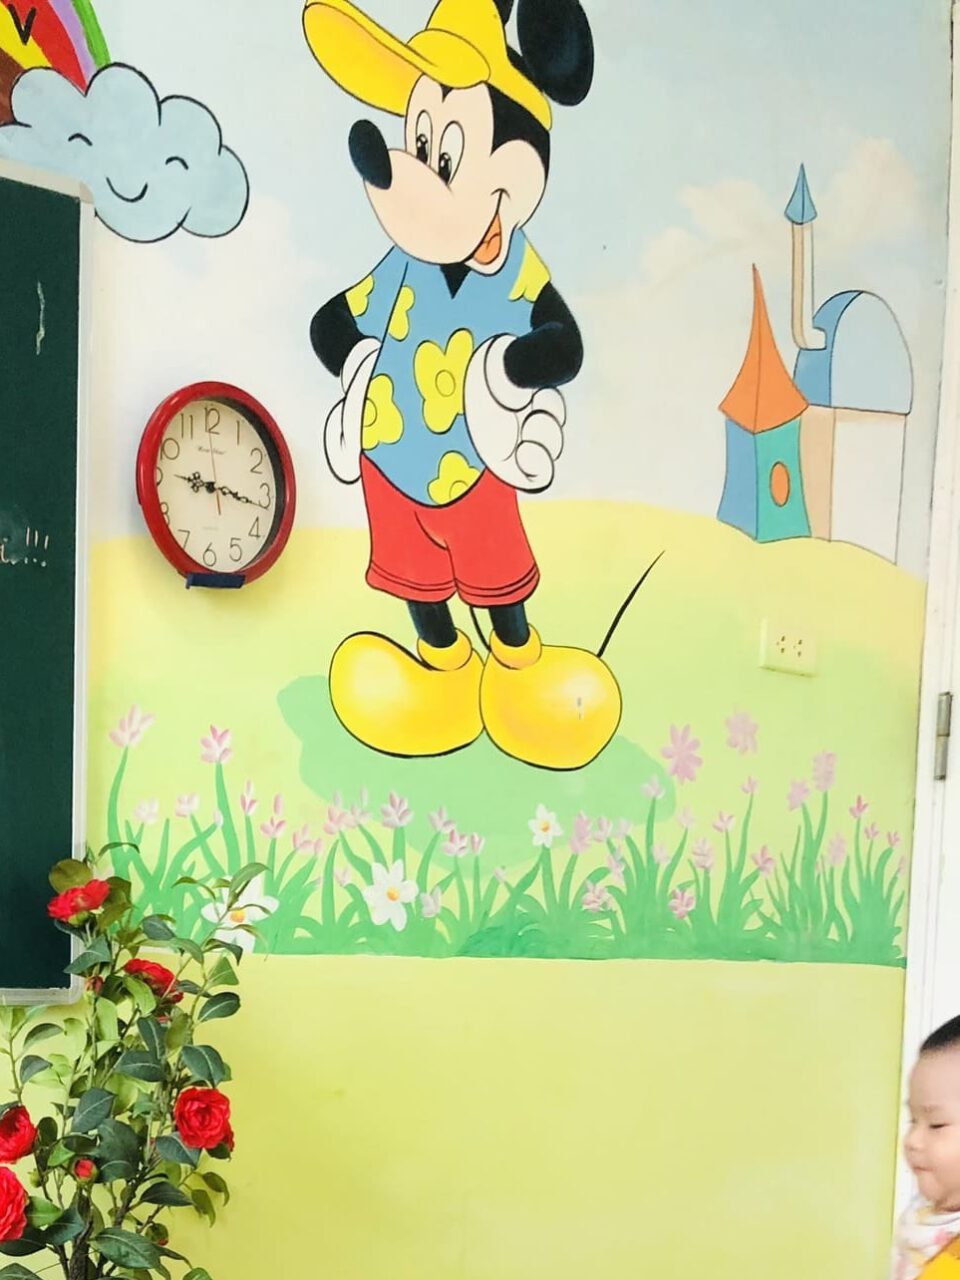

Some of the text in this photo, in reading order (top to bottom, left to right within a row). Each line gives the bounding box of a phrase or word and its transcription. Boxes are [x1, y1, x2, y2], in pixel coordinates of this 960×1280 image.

[7, 4, 37, 45] V
[179, 413, 241, 446] 11 1
[204, 407, 220, 435] 12
[249, 447, 263, 475] 2
[257, 482, 271, 511] 3
[247, 516, 262, 540] 4
[202, 541, 217, 567] 6
[228, 537, 243, 562] 5
